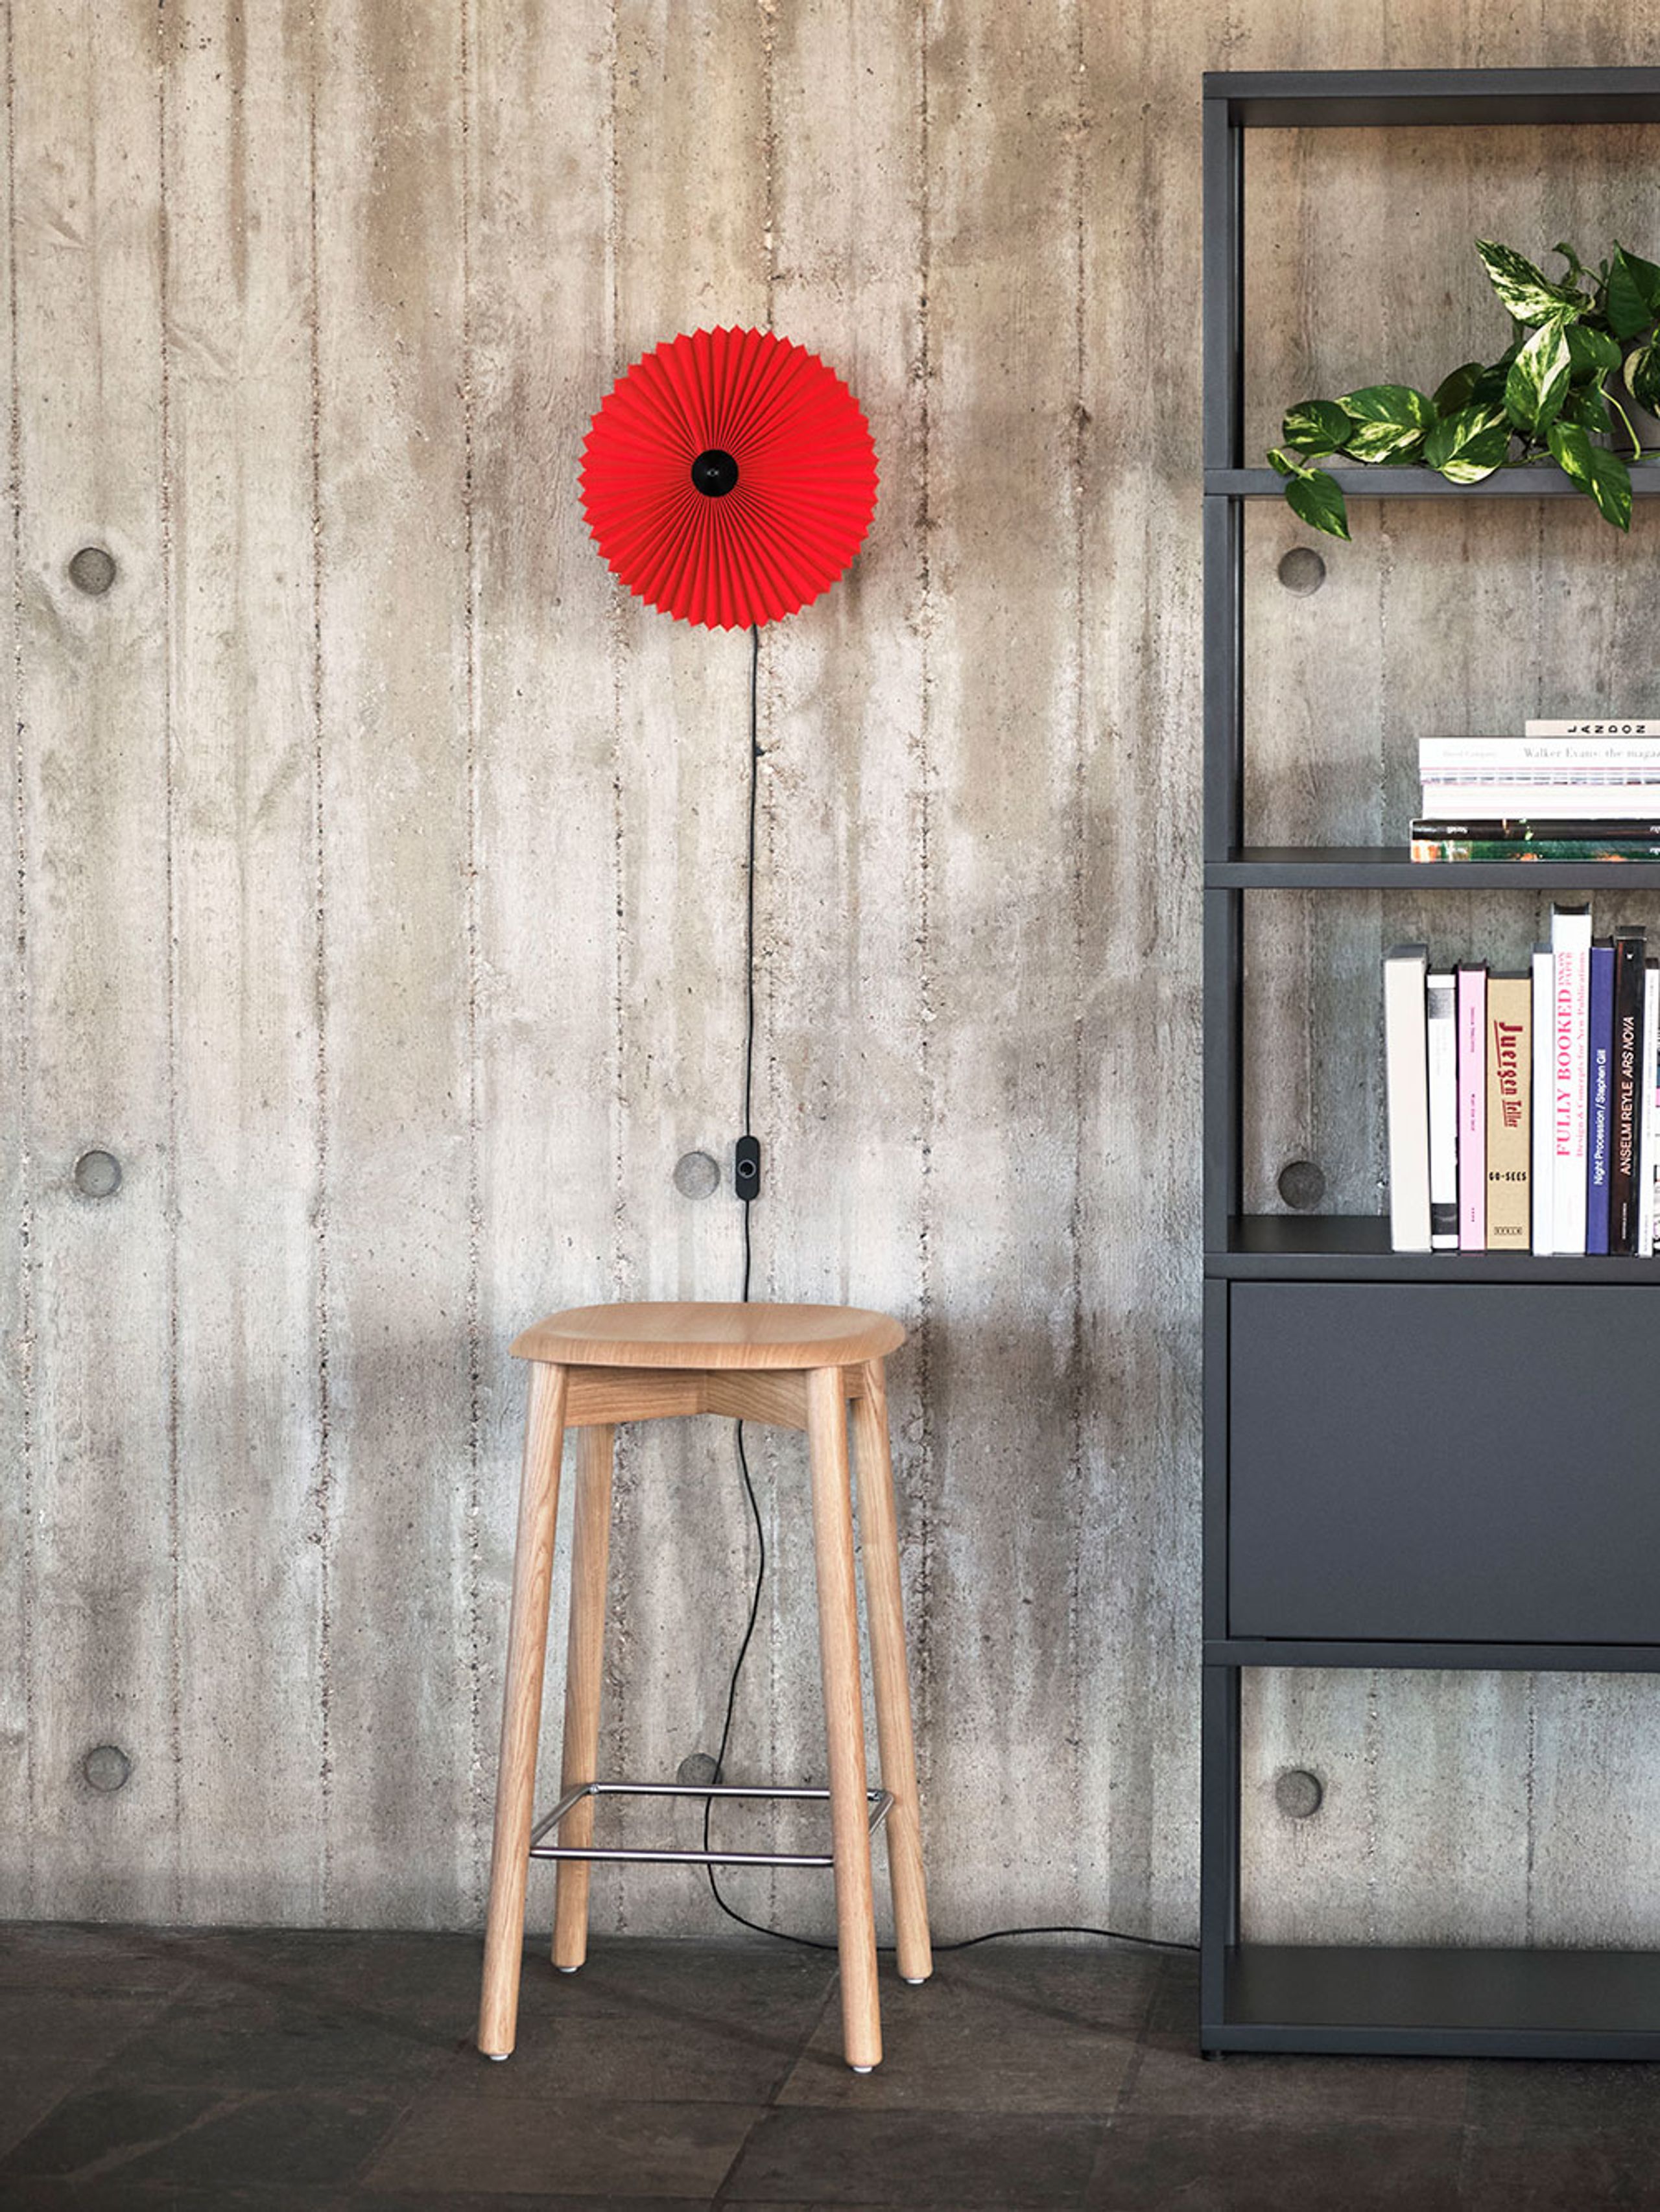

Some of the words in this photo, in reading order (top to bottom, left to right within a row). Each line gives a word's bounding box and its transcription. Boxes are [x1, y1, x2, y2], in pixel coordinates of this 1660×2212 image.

[1567, 725, 1646, 735] LANDON
[1523, 747, 1562, 758] Walker
[1605, 747, 1623, 758] the
[1577, 951, 1585, 1016] Publications
[1557, 989, 1572, 1080] BOOKED
[1576, 1019, 1585, 1041] New
[1622, 1015, 1635, 1051] NOVA
[1496, 1022, 1523, 1095] Juergen
[1596, 1049, 1607, 1065] Gill
[1622, 1050, 1634, 1078] ARS
[1595, 1065, 1607, 1103] Stephen
[1621, 1081, 1633, 1122] REYLE
[1504, 1100, 1522, 1127] Teller
[1556, 1088, 1571, 1156] FULLY
[1576, 1122, 1585, 1158] Design
[1594, 1111, 1606, 1160] Procession
[1620, 1122, 1633, 1176] ANSELM
[1593, 1160, 1606, 1186] Night
